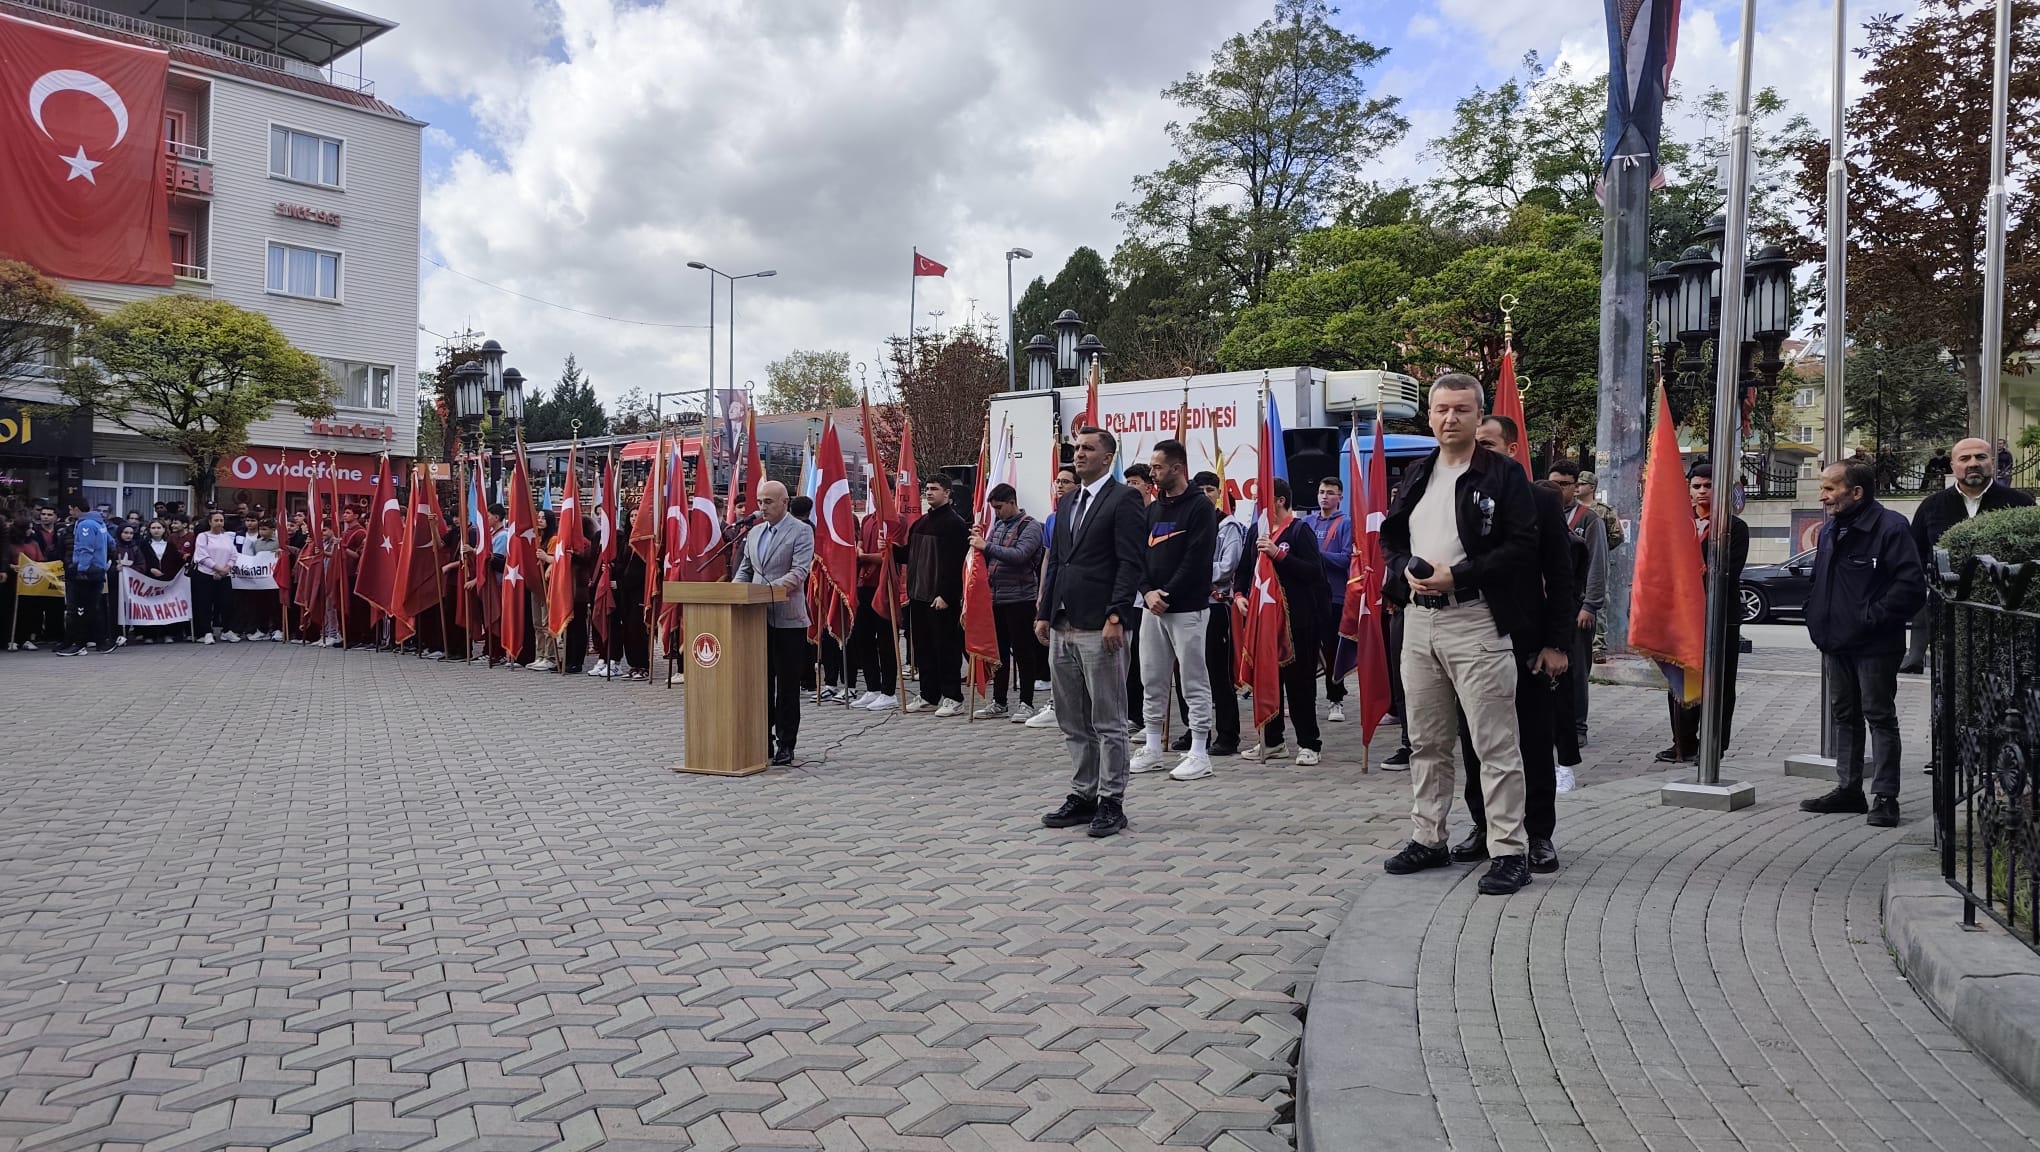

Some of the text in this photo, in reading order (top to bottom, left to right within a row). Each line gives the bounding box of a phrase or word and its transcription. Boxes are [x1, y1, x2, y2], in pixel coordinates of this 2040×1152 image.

[1105, 410, 1155, 433] POLATLI
[1159, 400, 1236, 431] BEEDİYESİ
[311, 418, 393, 441] hotel
[263, 460, 363, 482] vodafone
[154, 596, 188, 621] HATİP
